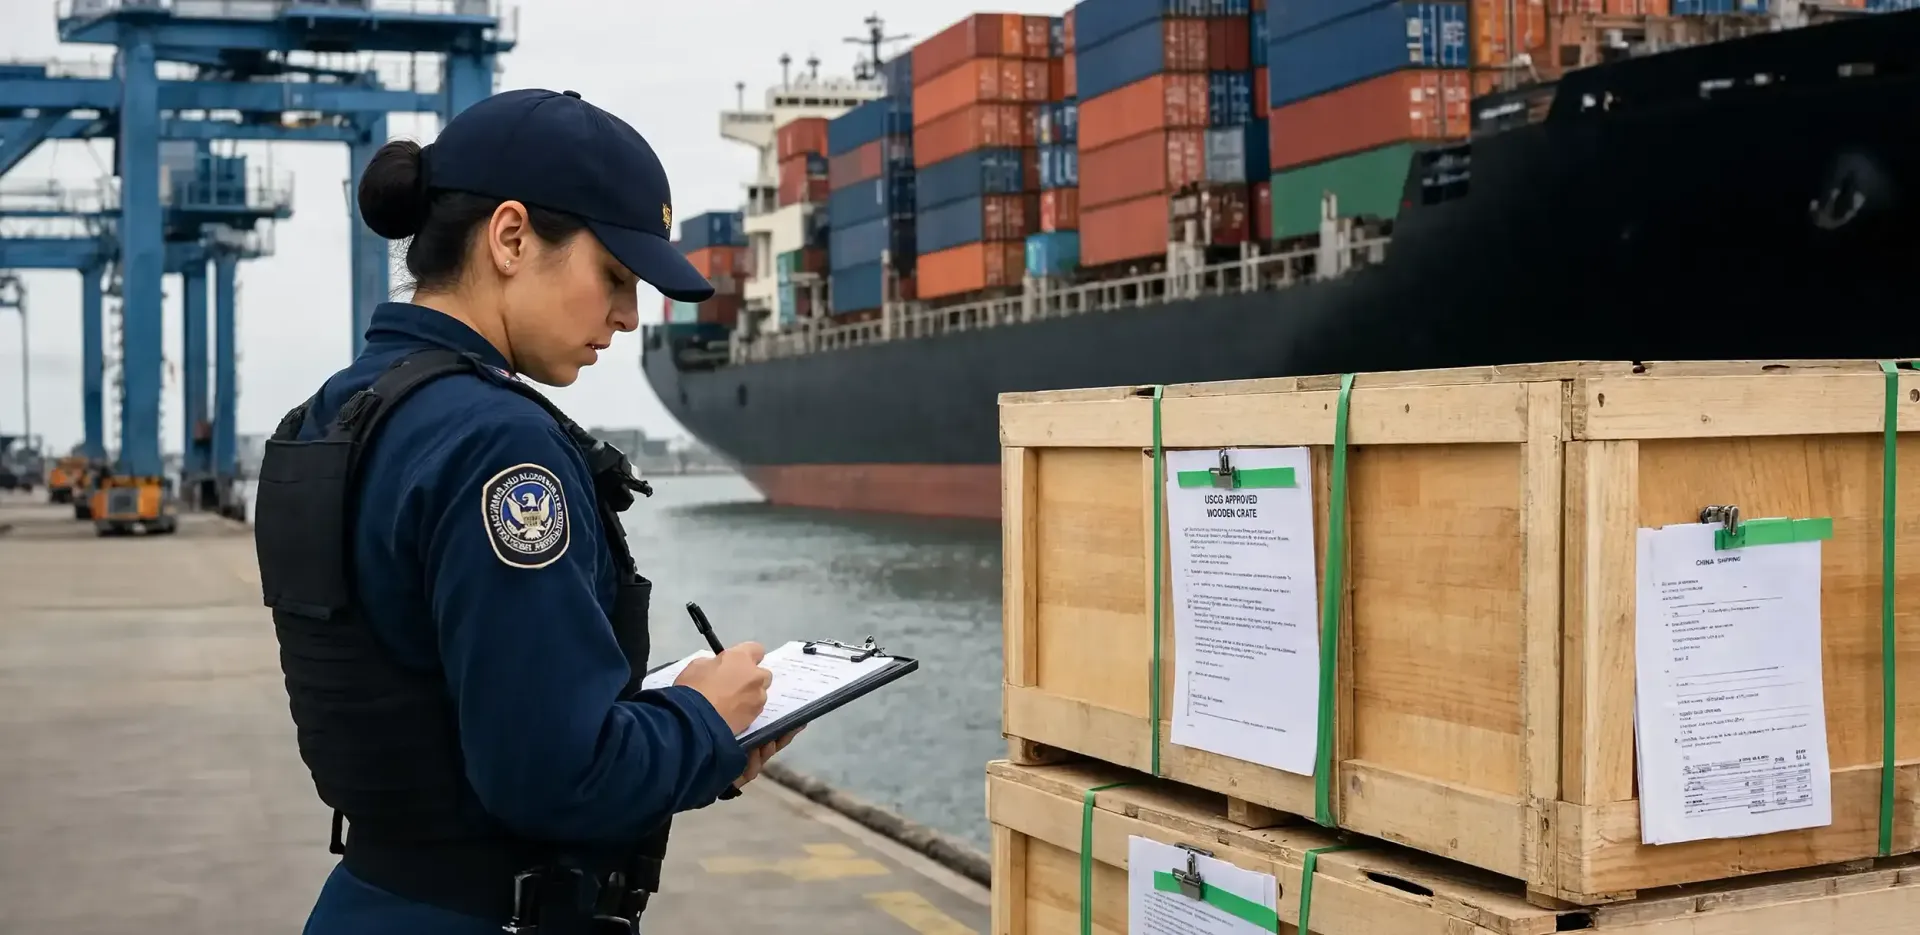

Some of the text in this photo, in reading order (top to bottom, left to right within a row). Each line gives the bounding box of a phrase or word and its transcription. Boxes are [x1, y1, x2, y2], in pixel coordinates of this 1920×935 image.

[1204, 494, 1258, 504] USCG APPROVED
[1207, 508, 1258, 518] WOODEN CRATE
